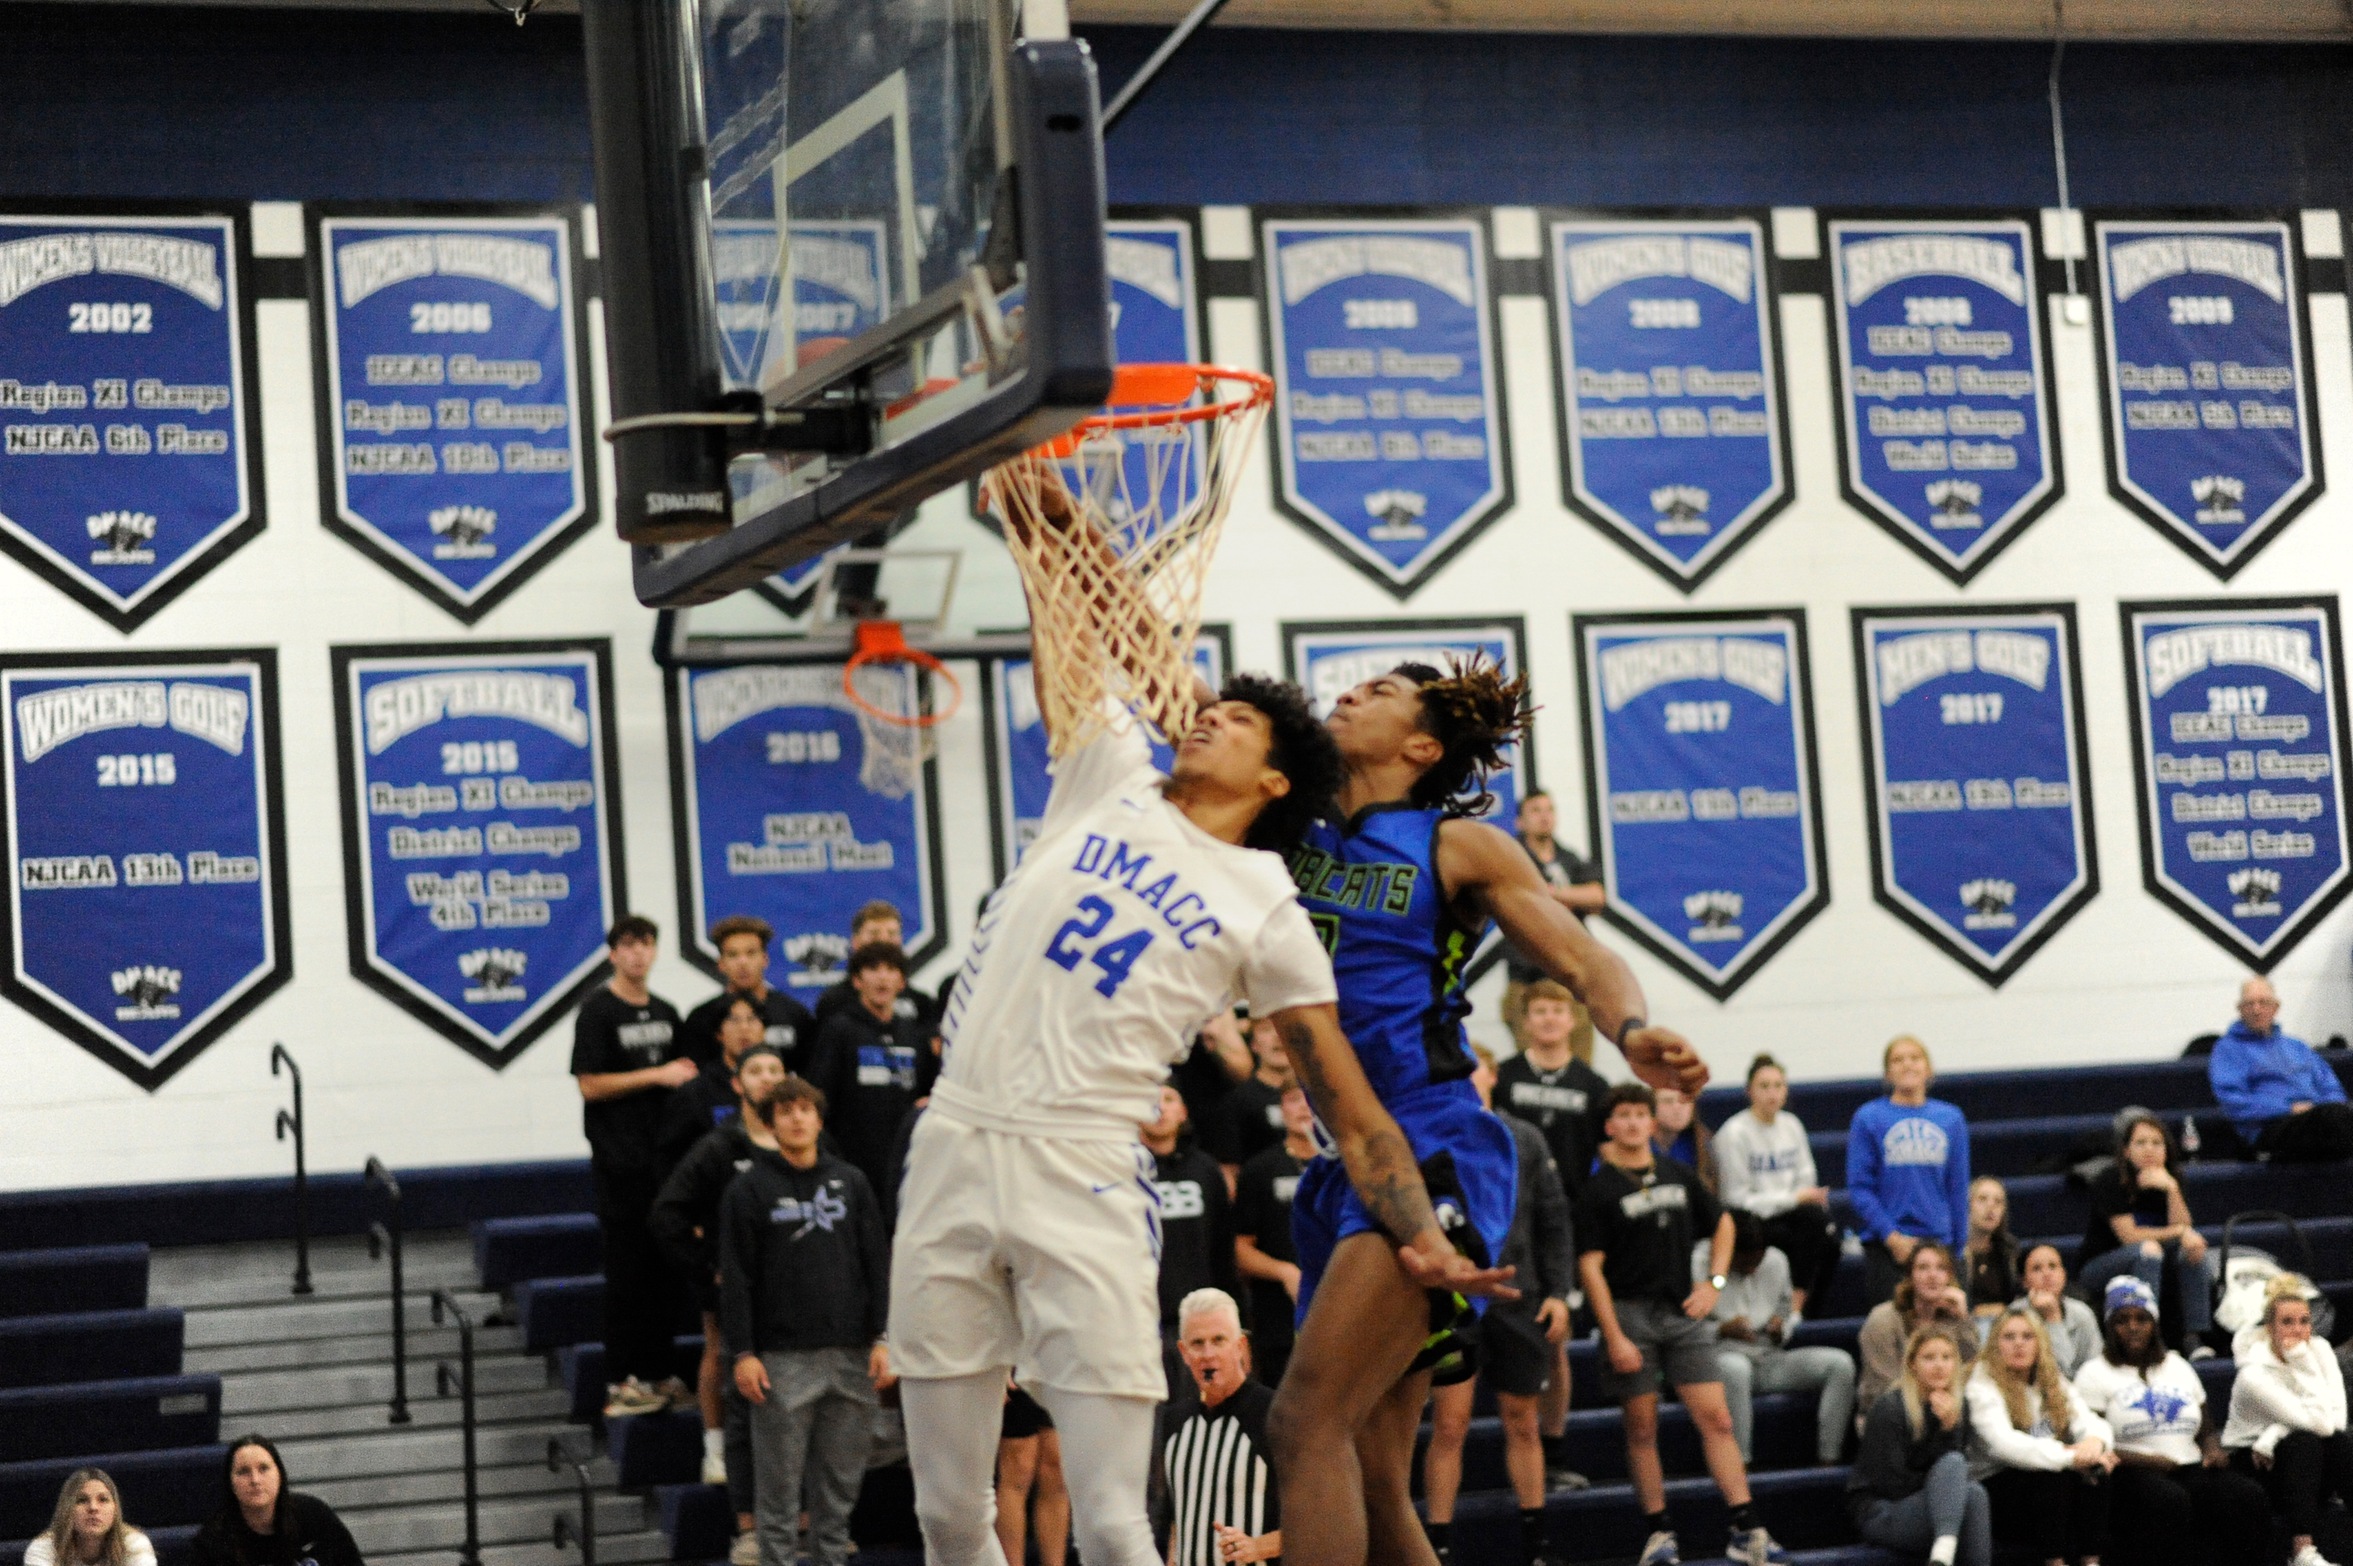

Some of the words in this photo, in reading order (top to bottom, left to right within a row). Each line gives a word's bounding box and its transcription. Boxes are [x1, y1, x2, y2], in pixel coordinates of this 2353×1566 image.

[69, 302, 152, 333] 2002
[448, 354, 542, 389] Champs
[0, 379, 87, 414] Region
[93, 379, 128, 408] XI
[133, 378, 230, 414] Champs
[345, 400, 431, 435] Region
[475, 398, 566, 434] Champs
[6, 424, 100, 454] NJCAA
[156, 424, 228, 454] Place
[347, 443, 437, 475] NJCAA
[503, 441, 571, 473] Place
[646, 492, 723, 515] SPALDING
[2146, 625, 2322, 699] SOFTBALL
[366, 670, 588, 756] SOFTBALL
[1664, 701, 1731, 733] 2017
[1939, 692, 2003, 724] 2017
[2207, 685, 2268, 715] 2017
[17, 680, 168, 764] WOMEN'S
[168, 682, 248, 757] GOLF
[96, 753, 176, 787] 2015
[370, 782, 458, 819] Region
[461, 777, 497, 812] XI
[500, 776, 593, 812] Champs
[388, 826, 483, 860] District
[486, 822, 581, 858] Champs
[764, 812, 854, 845] NJCAA
[22, 855, 117, 890] NJCAA
[123, 853, 183, 886] 13th
[187, 851, 260, 884] Place
[727, 841, 829, 876] National
[406, 871, 483, 905] World
[489, 870, 570, 900] Series
[1073, 834, 1221, 951] DMACC
[430, 900, 477, 931] 4th
[480, 896, 550, 929] Place
[1044, 894, 1155, 999] 24
